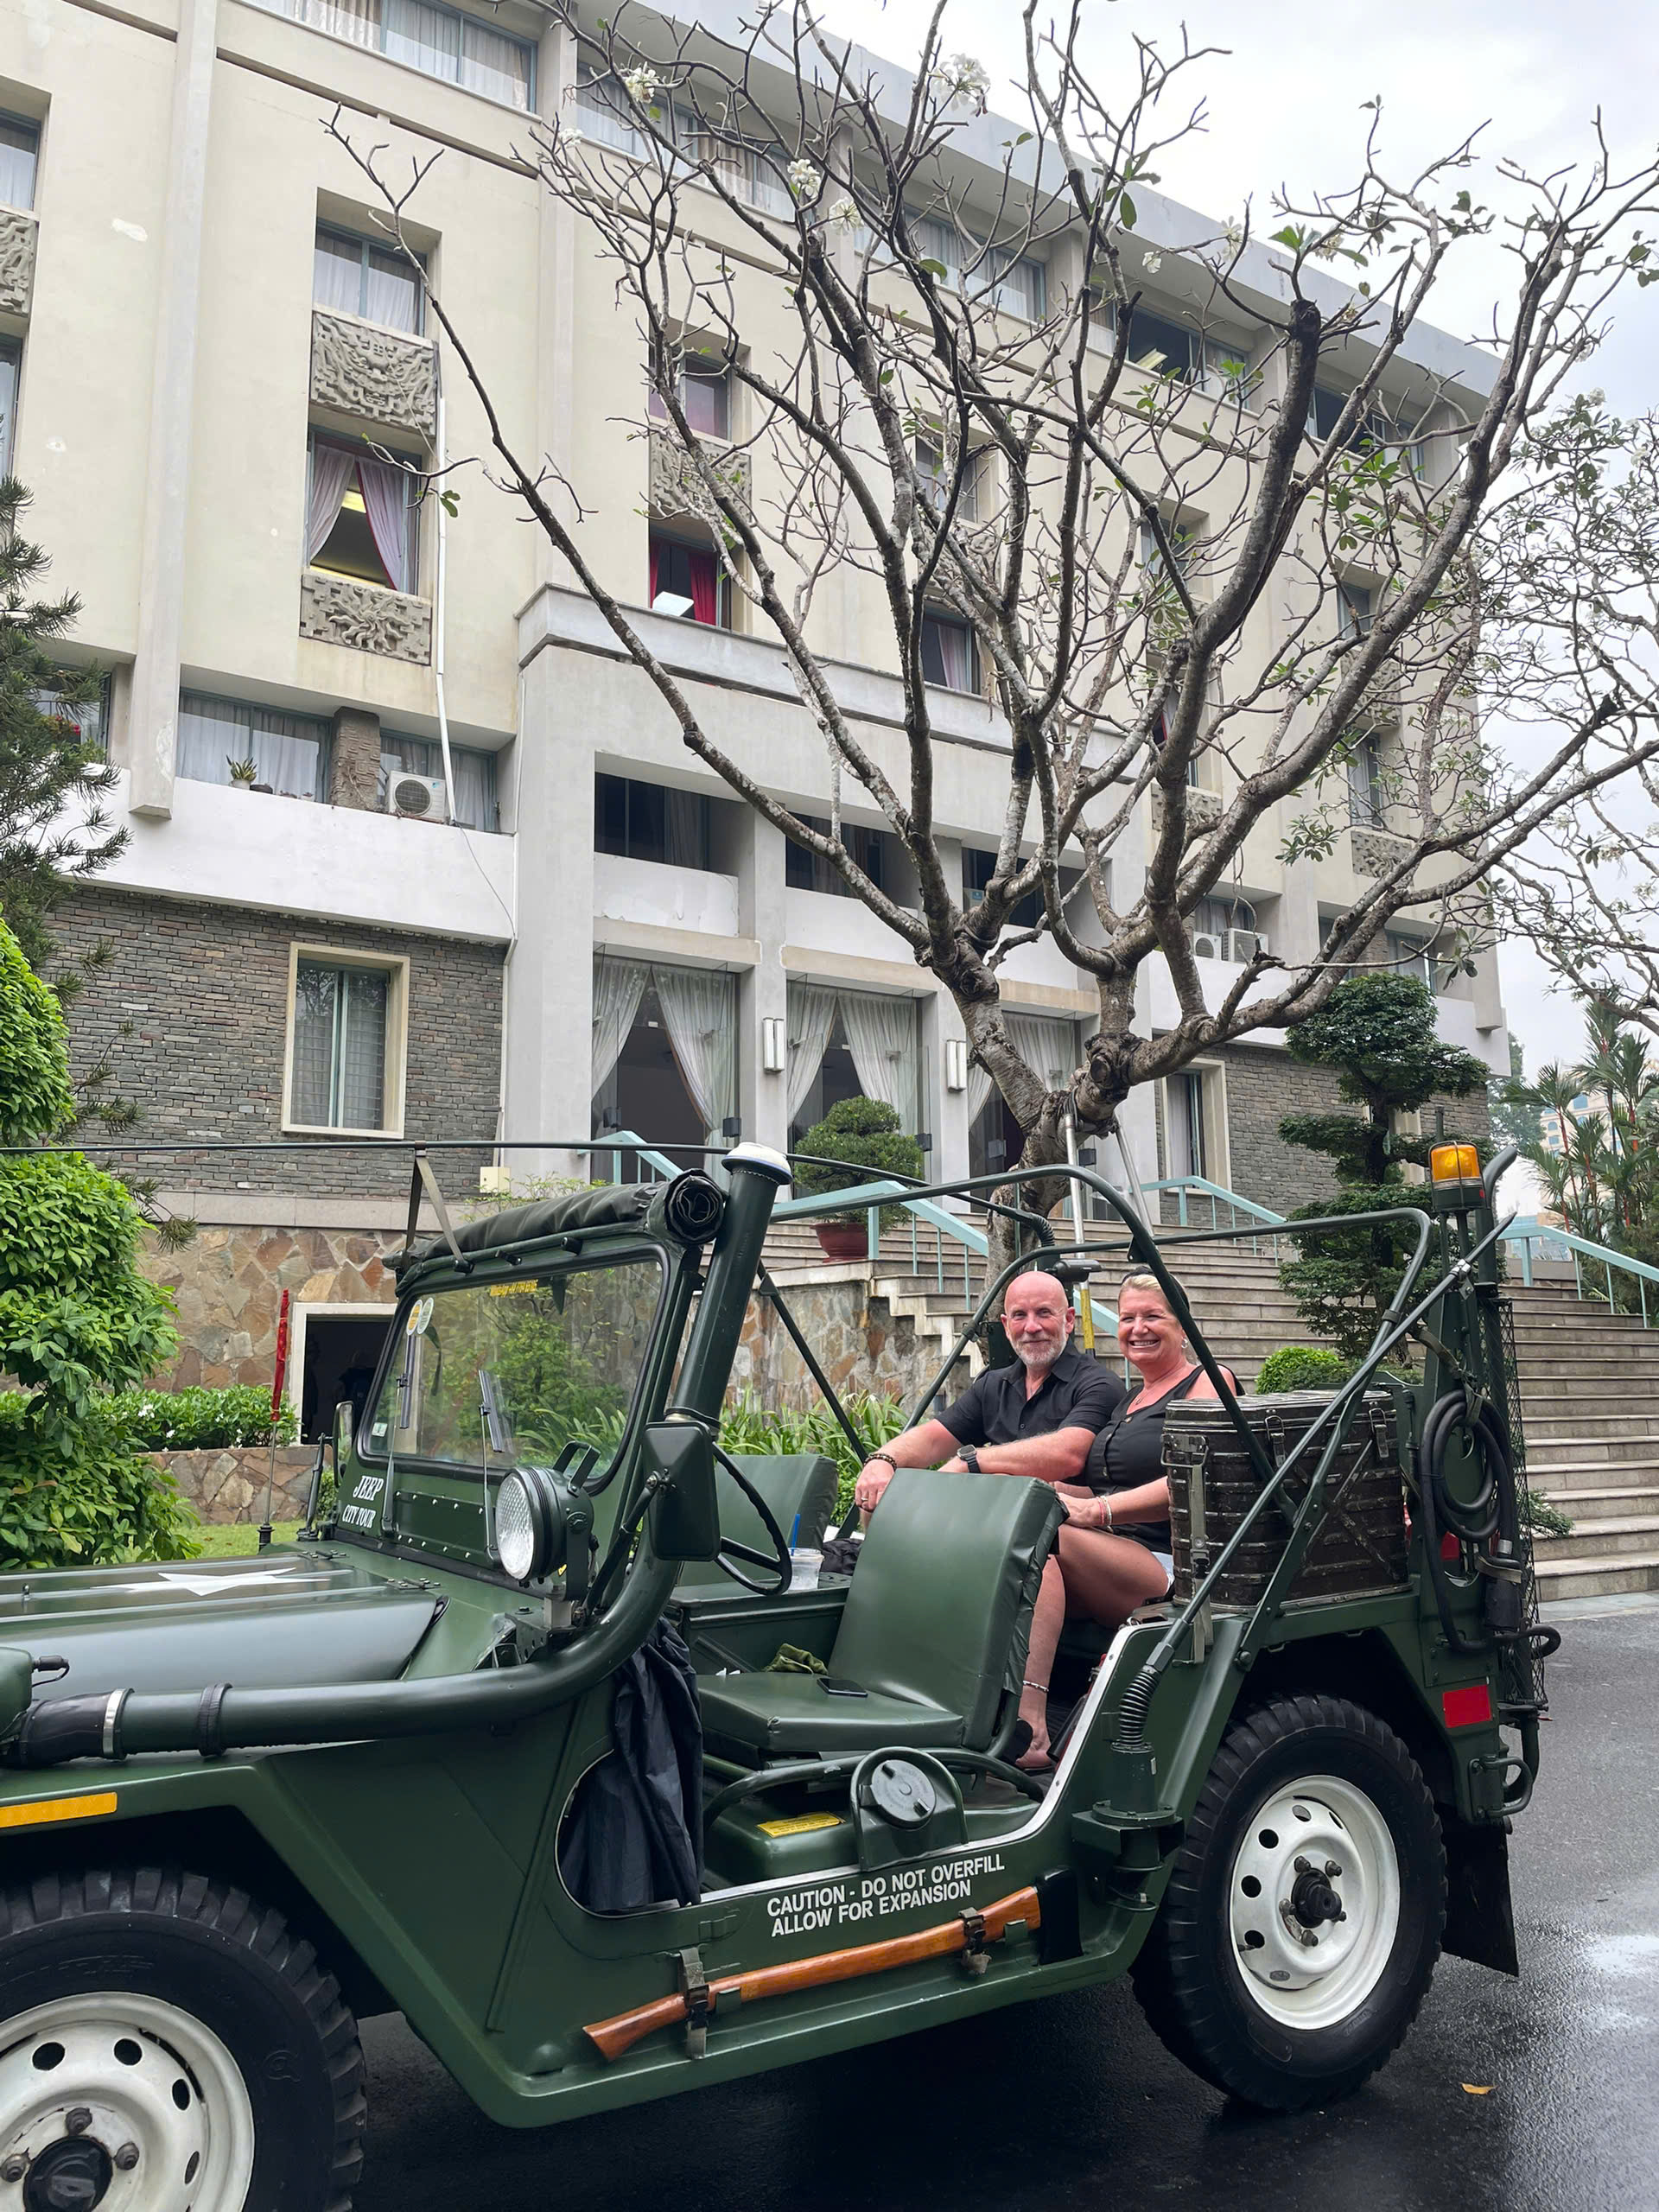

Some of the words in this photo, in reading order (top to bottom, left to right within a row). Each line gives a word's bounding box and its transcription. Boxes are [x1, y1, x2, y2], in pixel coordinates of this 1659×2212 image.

[353, 1475, 385, 1501] JEEP
[342, 1504, 360, 1524] CITY
[355, 1507, 377, 1529] TOUR
[767, 1885, 845, 1916] CAUTION
[861, 1877, 887, 1899] DO
[892, 1869, 926, 1892] NOT
[931, 1853, 1005, 1883] OVERFILL
[771, 1906, 832, 1937] ALLOW
[838, 1901, 874, 1923] FOR
[879, 1878, 971, 1915] EXPANSION
